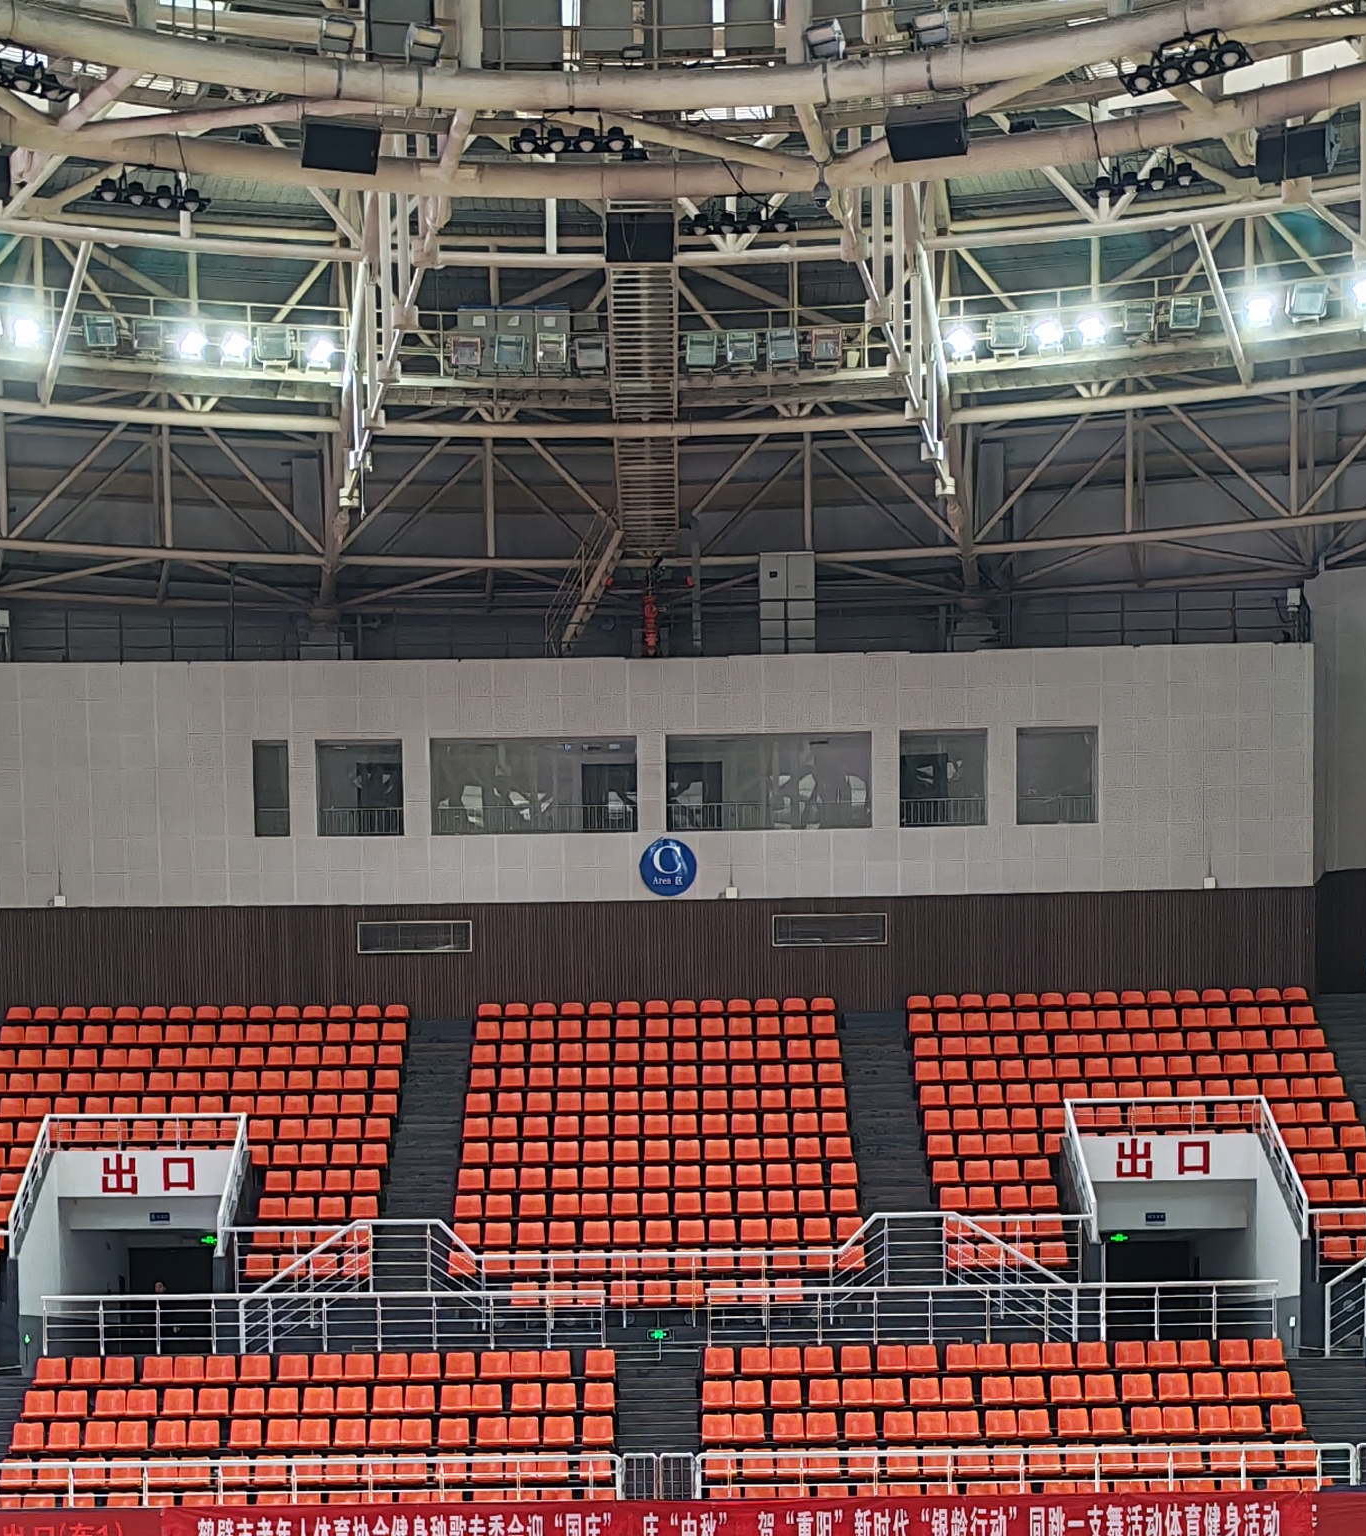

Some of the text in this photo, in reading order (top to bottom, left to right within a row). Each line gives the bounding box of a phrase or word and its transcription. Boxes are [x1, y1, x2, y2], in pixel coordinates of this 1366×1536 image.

[653, 845, 682, 874] C
[102, 1153, 196, 1195] 出口
[1116, 1138, 1211, 1179] 出口
